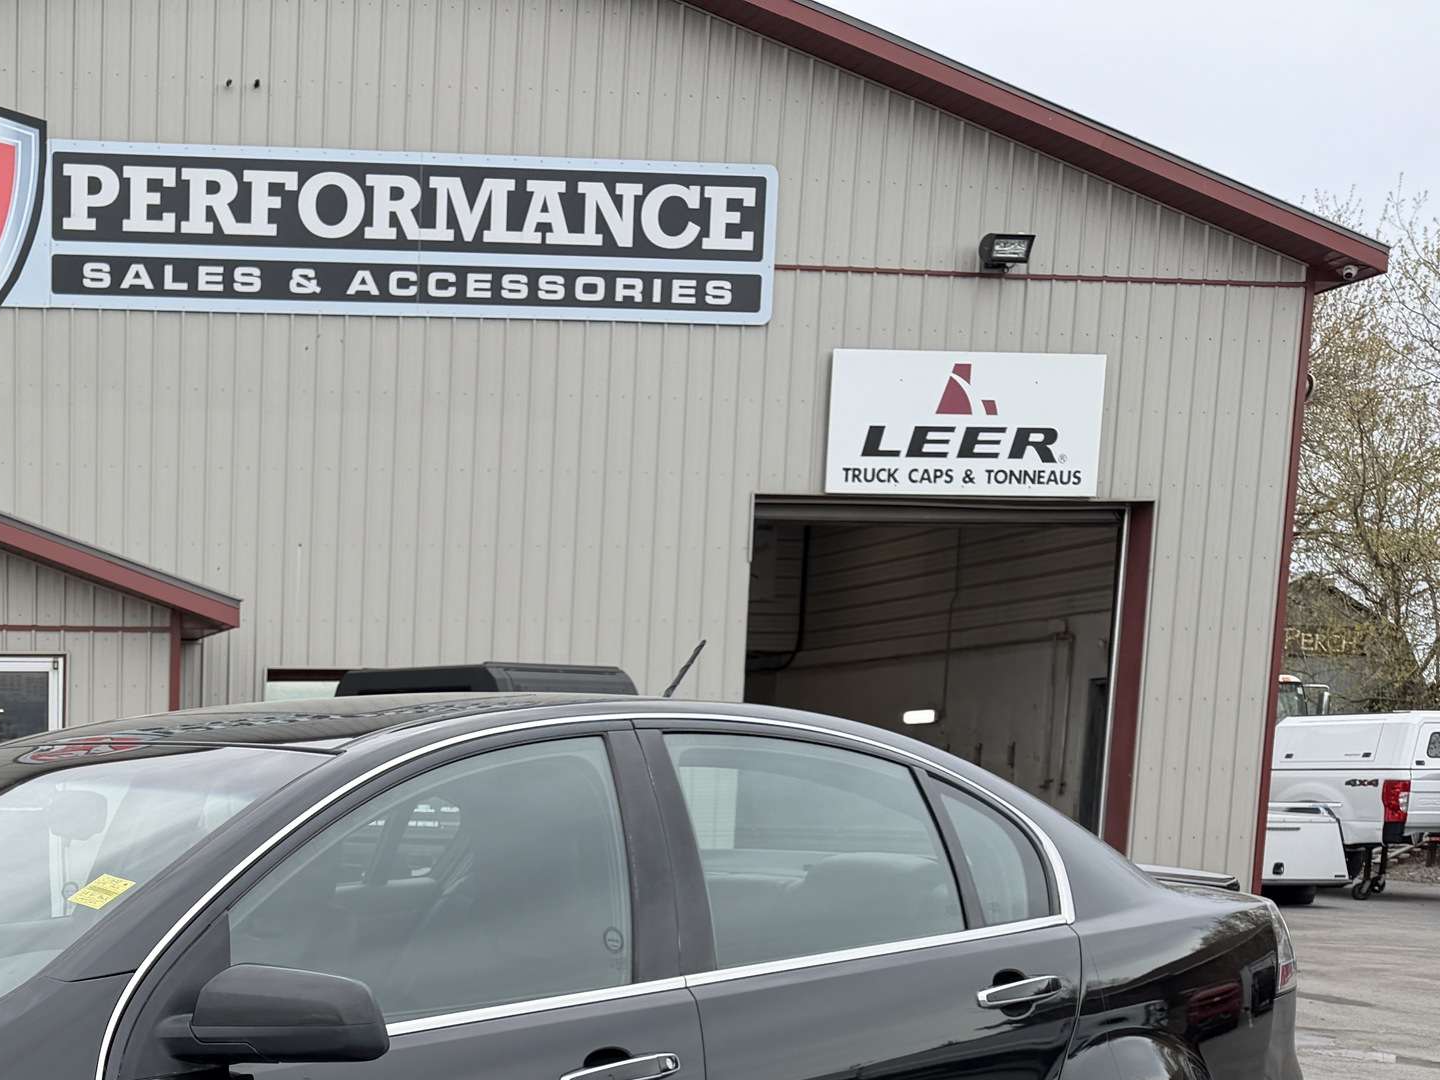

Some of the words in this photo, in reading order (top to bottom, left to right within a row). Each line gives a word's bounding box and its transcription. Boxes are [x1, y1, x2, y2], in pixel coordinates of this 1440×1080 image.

[62, 162, 757, 251] PERFORMANCE
[82, 262, 262, 293] SALES
[289, 268, 322, 294] &
[346, 269, 733, 306] ACCESSORIES
[861, 425, 1059, 464] LEER
[842, 467, 899, 484] TRUCK
[908, 468, 954, 484] CAPS
[962, 469, 976, 485] &
[985, 469, 1082, 485] TONNEAUS
